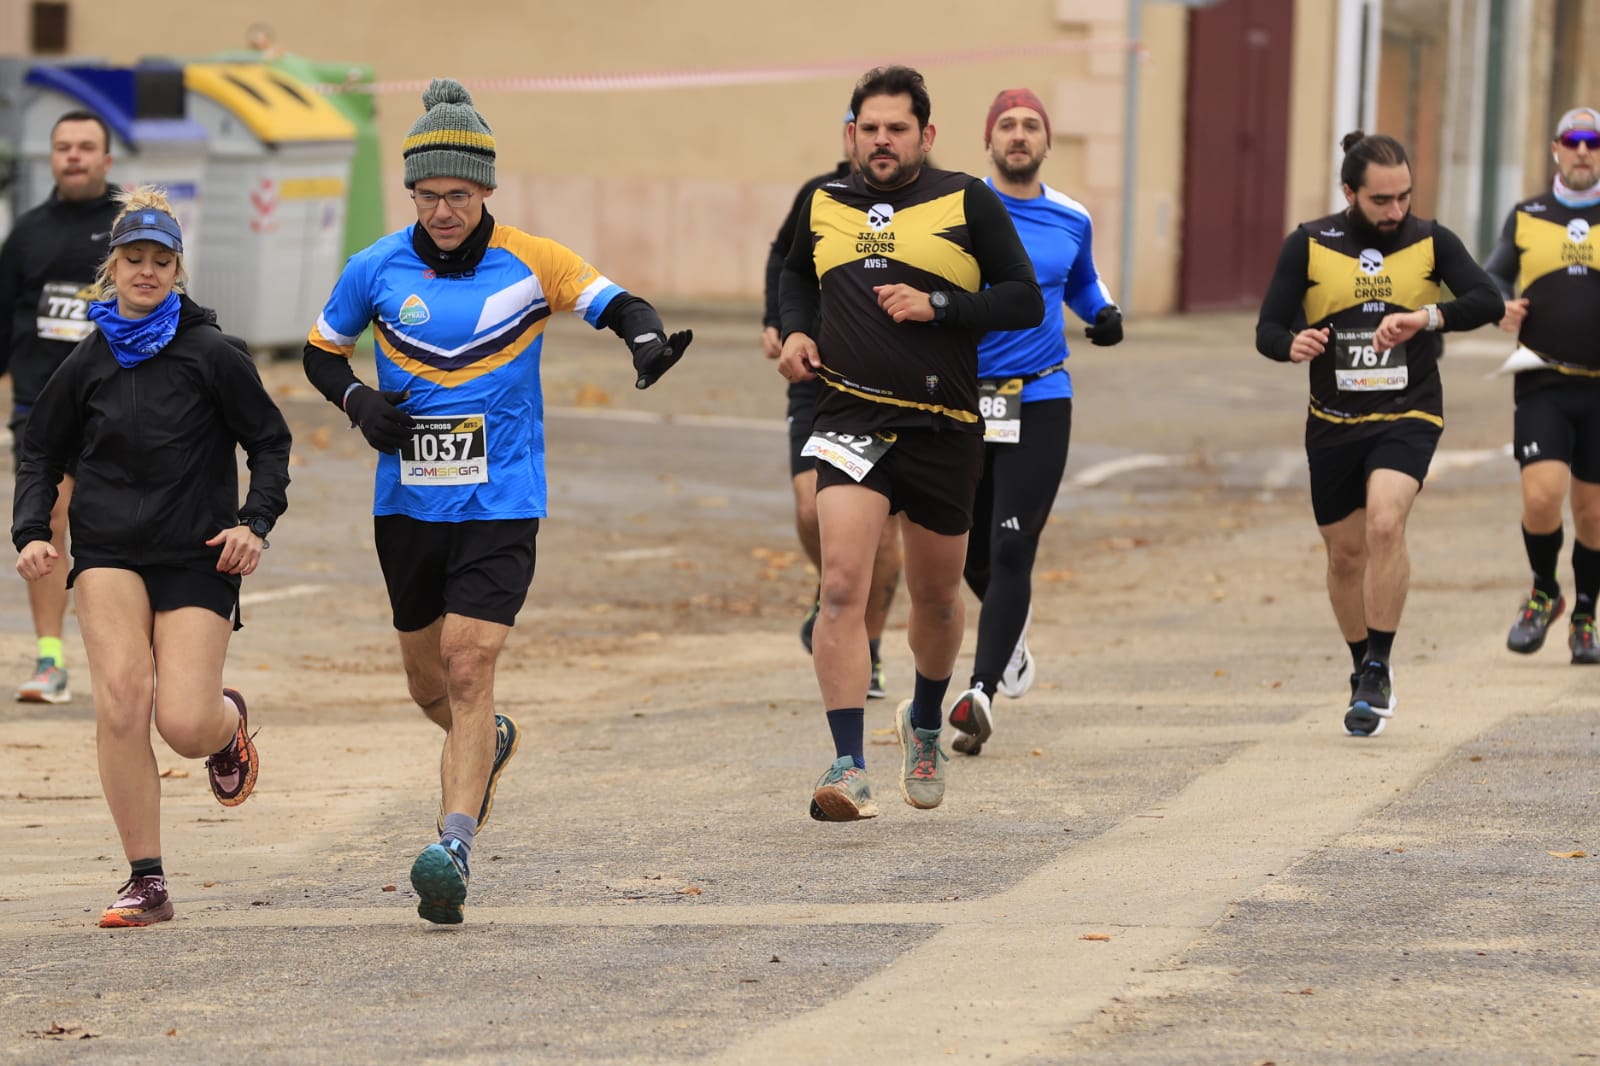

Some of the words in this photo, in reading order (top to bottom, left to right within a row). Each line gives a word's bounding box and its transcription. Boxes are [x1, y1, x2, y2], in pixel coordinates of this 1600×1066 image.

[855, 242, 895, 253] CROSS
[864, 258, 880, 269] AVS
[1354, 288, 1392, 299] CROSS
[48, 296, 86, 320] 772
[410, 432, 473, 461] 1037
[408, 466, 480, 477] JOMISAGA
